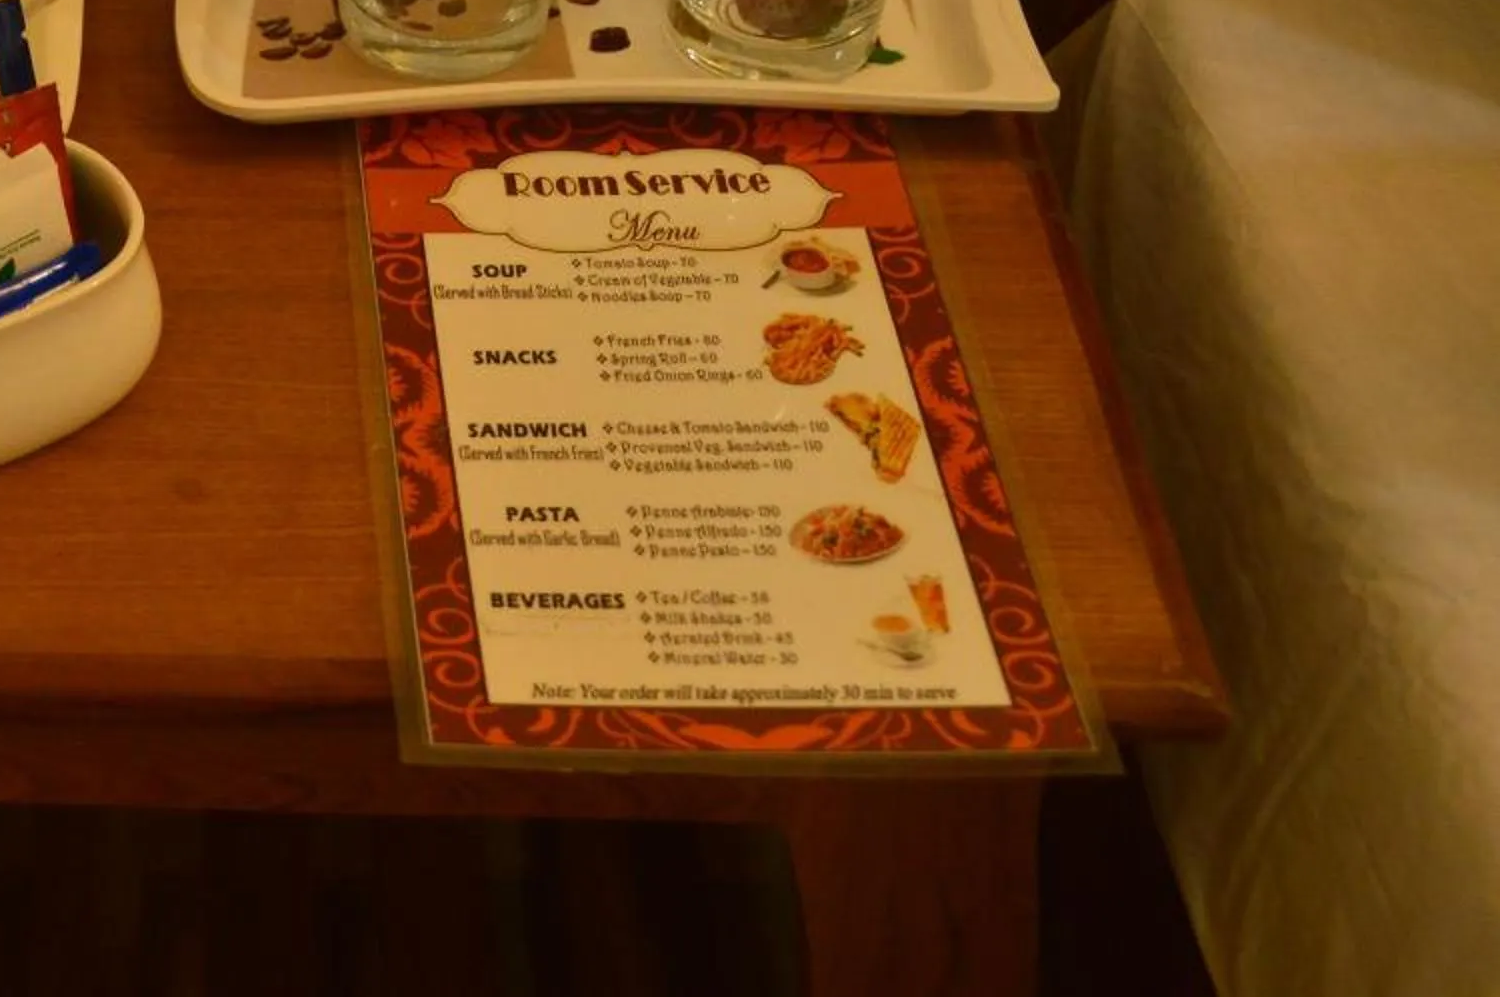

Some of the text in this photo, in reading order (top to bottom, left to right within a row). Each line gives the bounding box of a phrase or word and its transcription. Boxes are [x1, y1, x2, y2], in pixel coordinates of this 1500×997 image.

[503, 168, 771, 197] Room Service
[607, 209, 699, 243] Menu
[471, 264, 527, 278] SOUP
[588, 274, 631, 287] Cream
[633, 274, 647, 288] of
[650, 273, 711, 288] Vegetable
[478, 284, 500, 299] with
[650, 290, 683, 303] Soup
[607, 334, 656, 347] French
[658, 334, 692, 346] Fries
[473, 350, 557, 365] SNACKS
[611, 353, 657, 367] Spring
[658, 352, 687, 364] Roll
[614, 369, 651, 382] Fried
[654, 369, 694, 382] Onion
[696, 368, 735, 384] Rings
[468, 422, 587, 438] SANDWICH
[684, 421, 734, 434] Tomato
[735, 421, 798, 434] Sandwich
[505, 445, 528, 460] with
[727, 440, 791, 453] Sandwich
[624, 459, 692, 474] Vegetable
[695, 459, 759, 472] Sandwich
[505, 506, 580, 522] PASTA
[641, 505, 688, 519] Penne
[518, 531, 542, 546] with
[645, 524, 692, 539] Penne
[649, 544, 696, 558] Penne
[489, 592, 626, 609] BEVERAGES
[664, 651, 721, 666] Mineral
[580, 683, 615, 699] Your
[618, 684, 660, 699] order
[662, 684, 692, 699] will
[695, 685, 727, 699] take
[731, 684, 838, 703] approximately
[864, 685, 893, 700] min
[898, 686, 914, 700] to
[916, 687, 957, 700] serve
